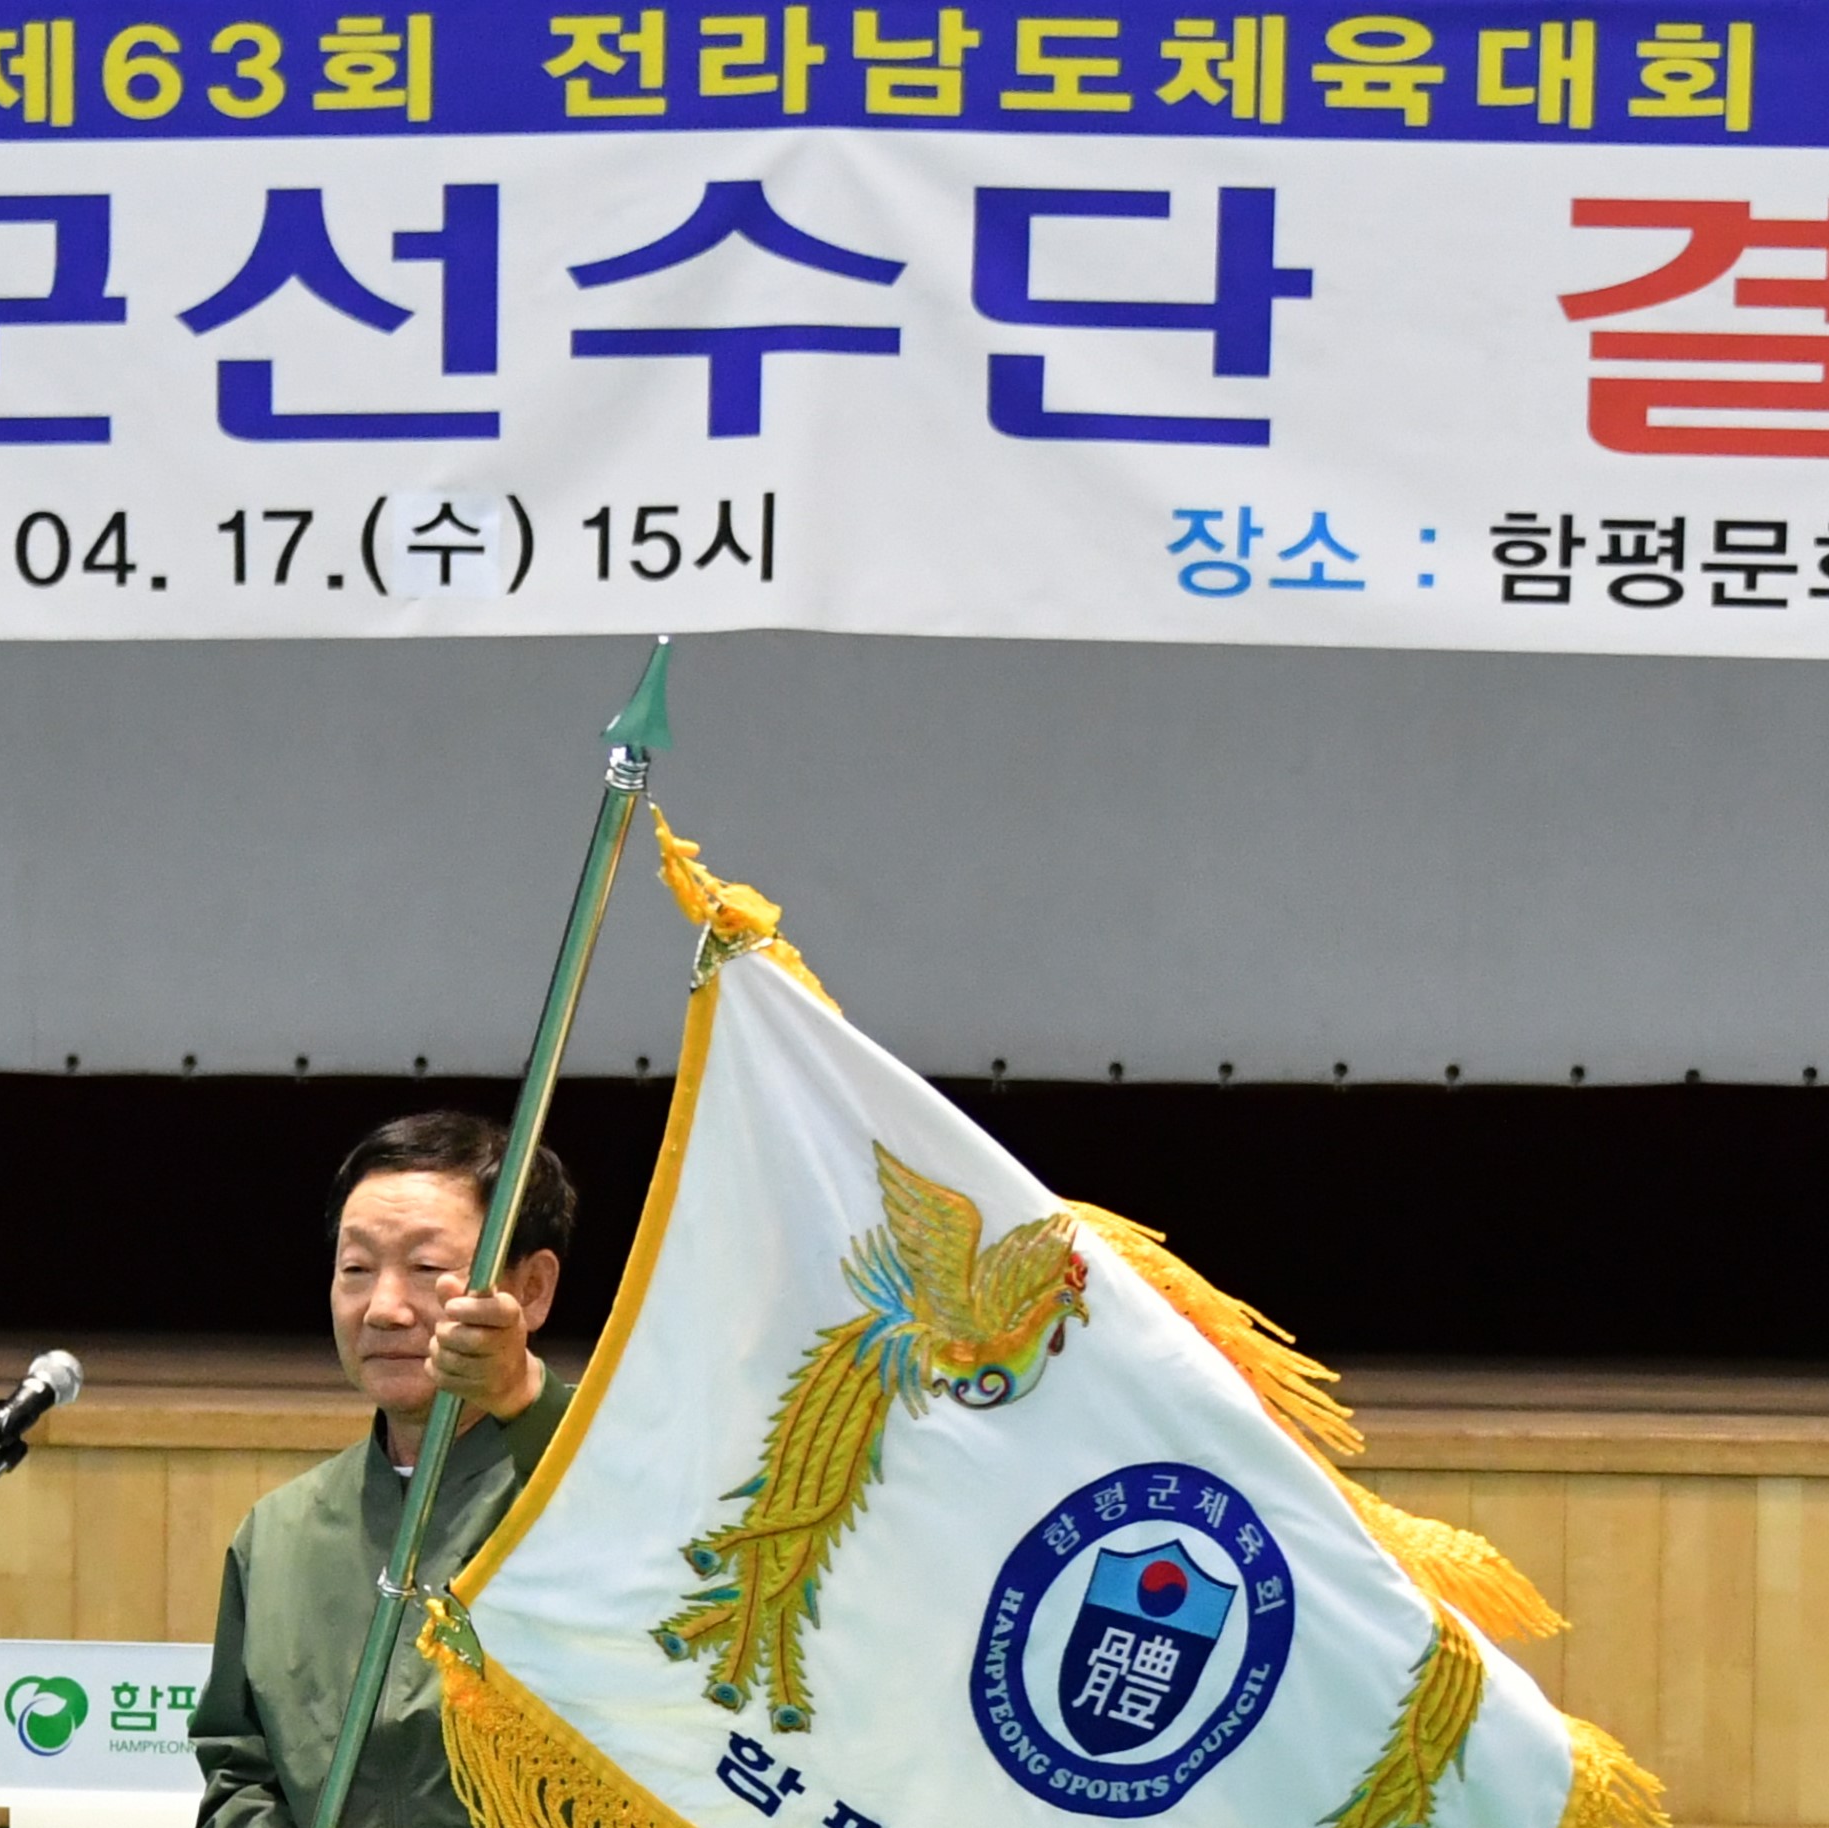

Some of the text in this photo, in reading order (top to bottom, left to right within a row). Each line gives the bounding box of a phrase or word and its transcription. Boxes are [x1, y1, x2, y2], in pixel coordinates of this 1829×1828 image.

[545, 6, 1754, 131] 전라남도체육대회
[14, 507, 167, 591] 04.
[581, 491, 778, 583] 15시
[1166, 505, 1368, 598] 장소
[983, 1586, 1271, 1803] HAMPYEONG SPORTS COUNCIL
[108, 1738, 196, 1755] HAMPYEON
